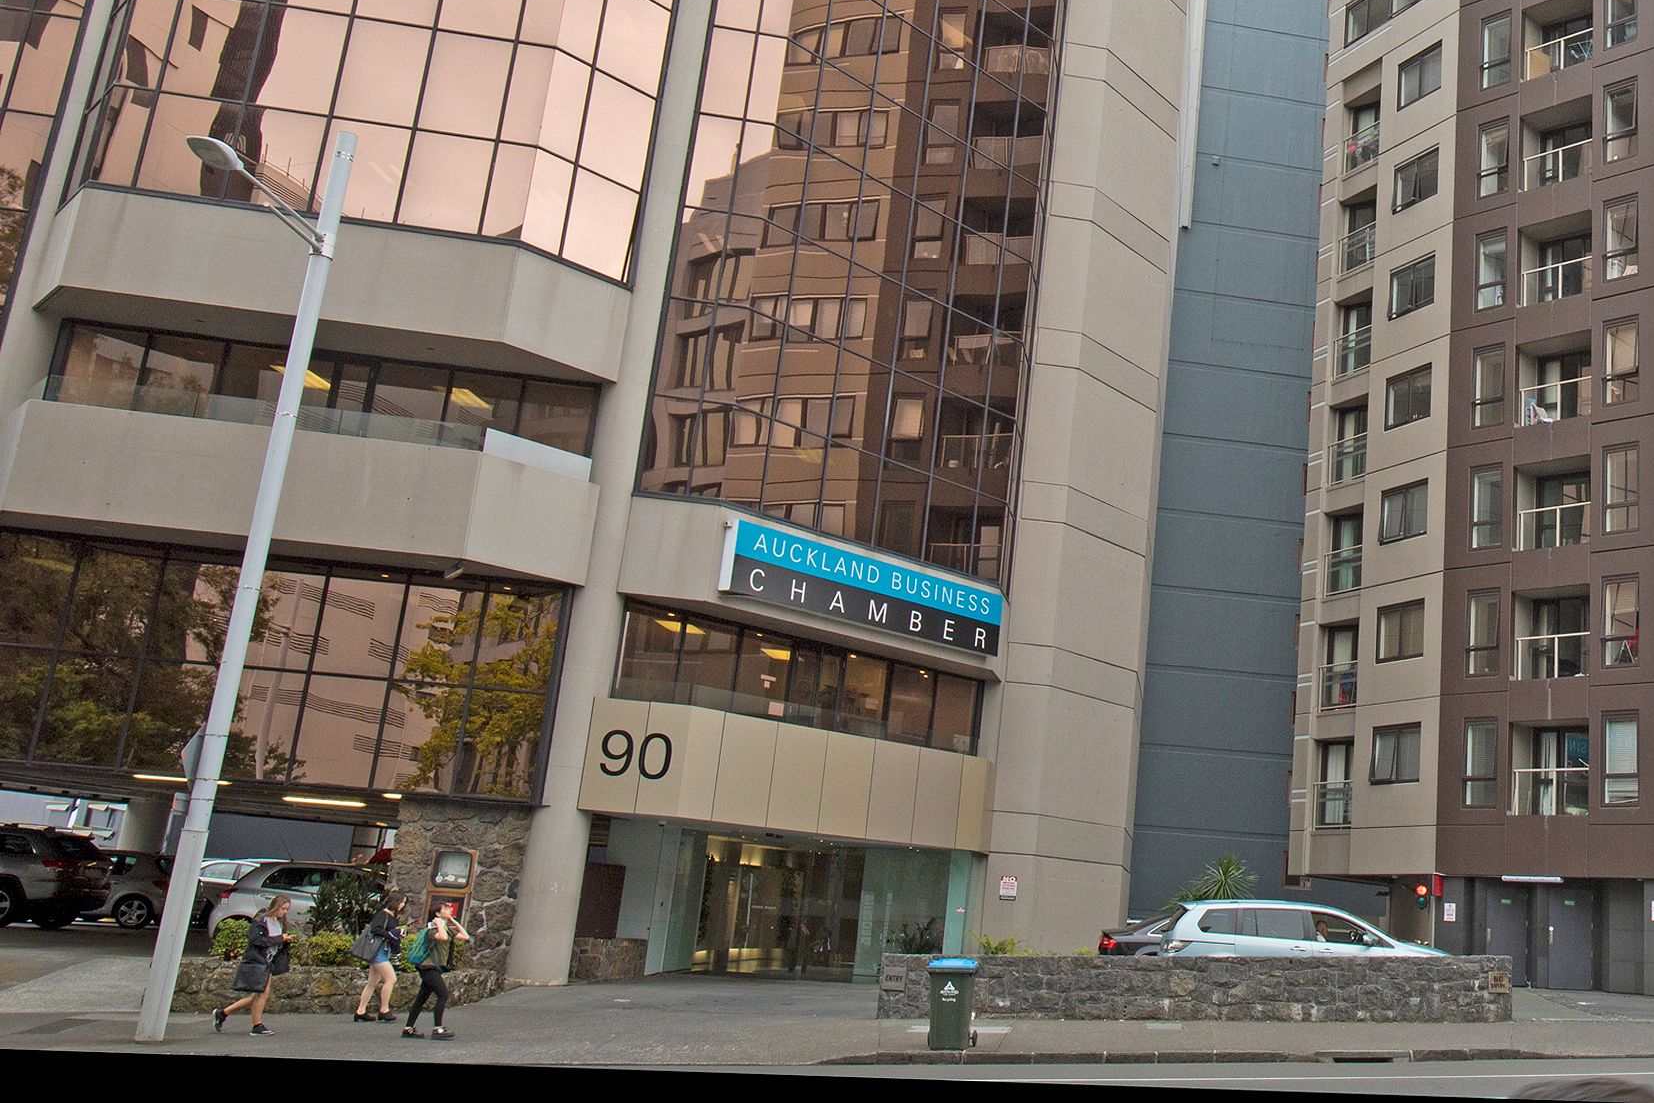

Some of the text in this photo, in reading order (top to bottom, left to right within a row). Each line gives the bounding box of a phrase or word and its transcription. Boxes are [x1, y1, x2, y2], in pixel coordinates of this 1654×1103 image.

[753, 533, 990, 615] AUCKLAND BUSINESS
[749, 568, 987, 649] CHAMBER
[599, 729, 673, 780] 90
[885, 974, 904, 982] ENTRY
[1493, 975, 1504, 983] NO
